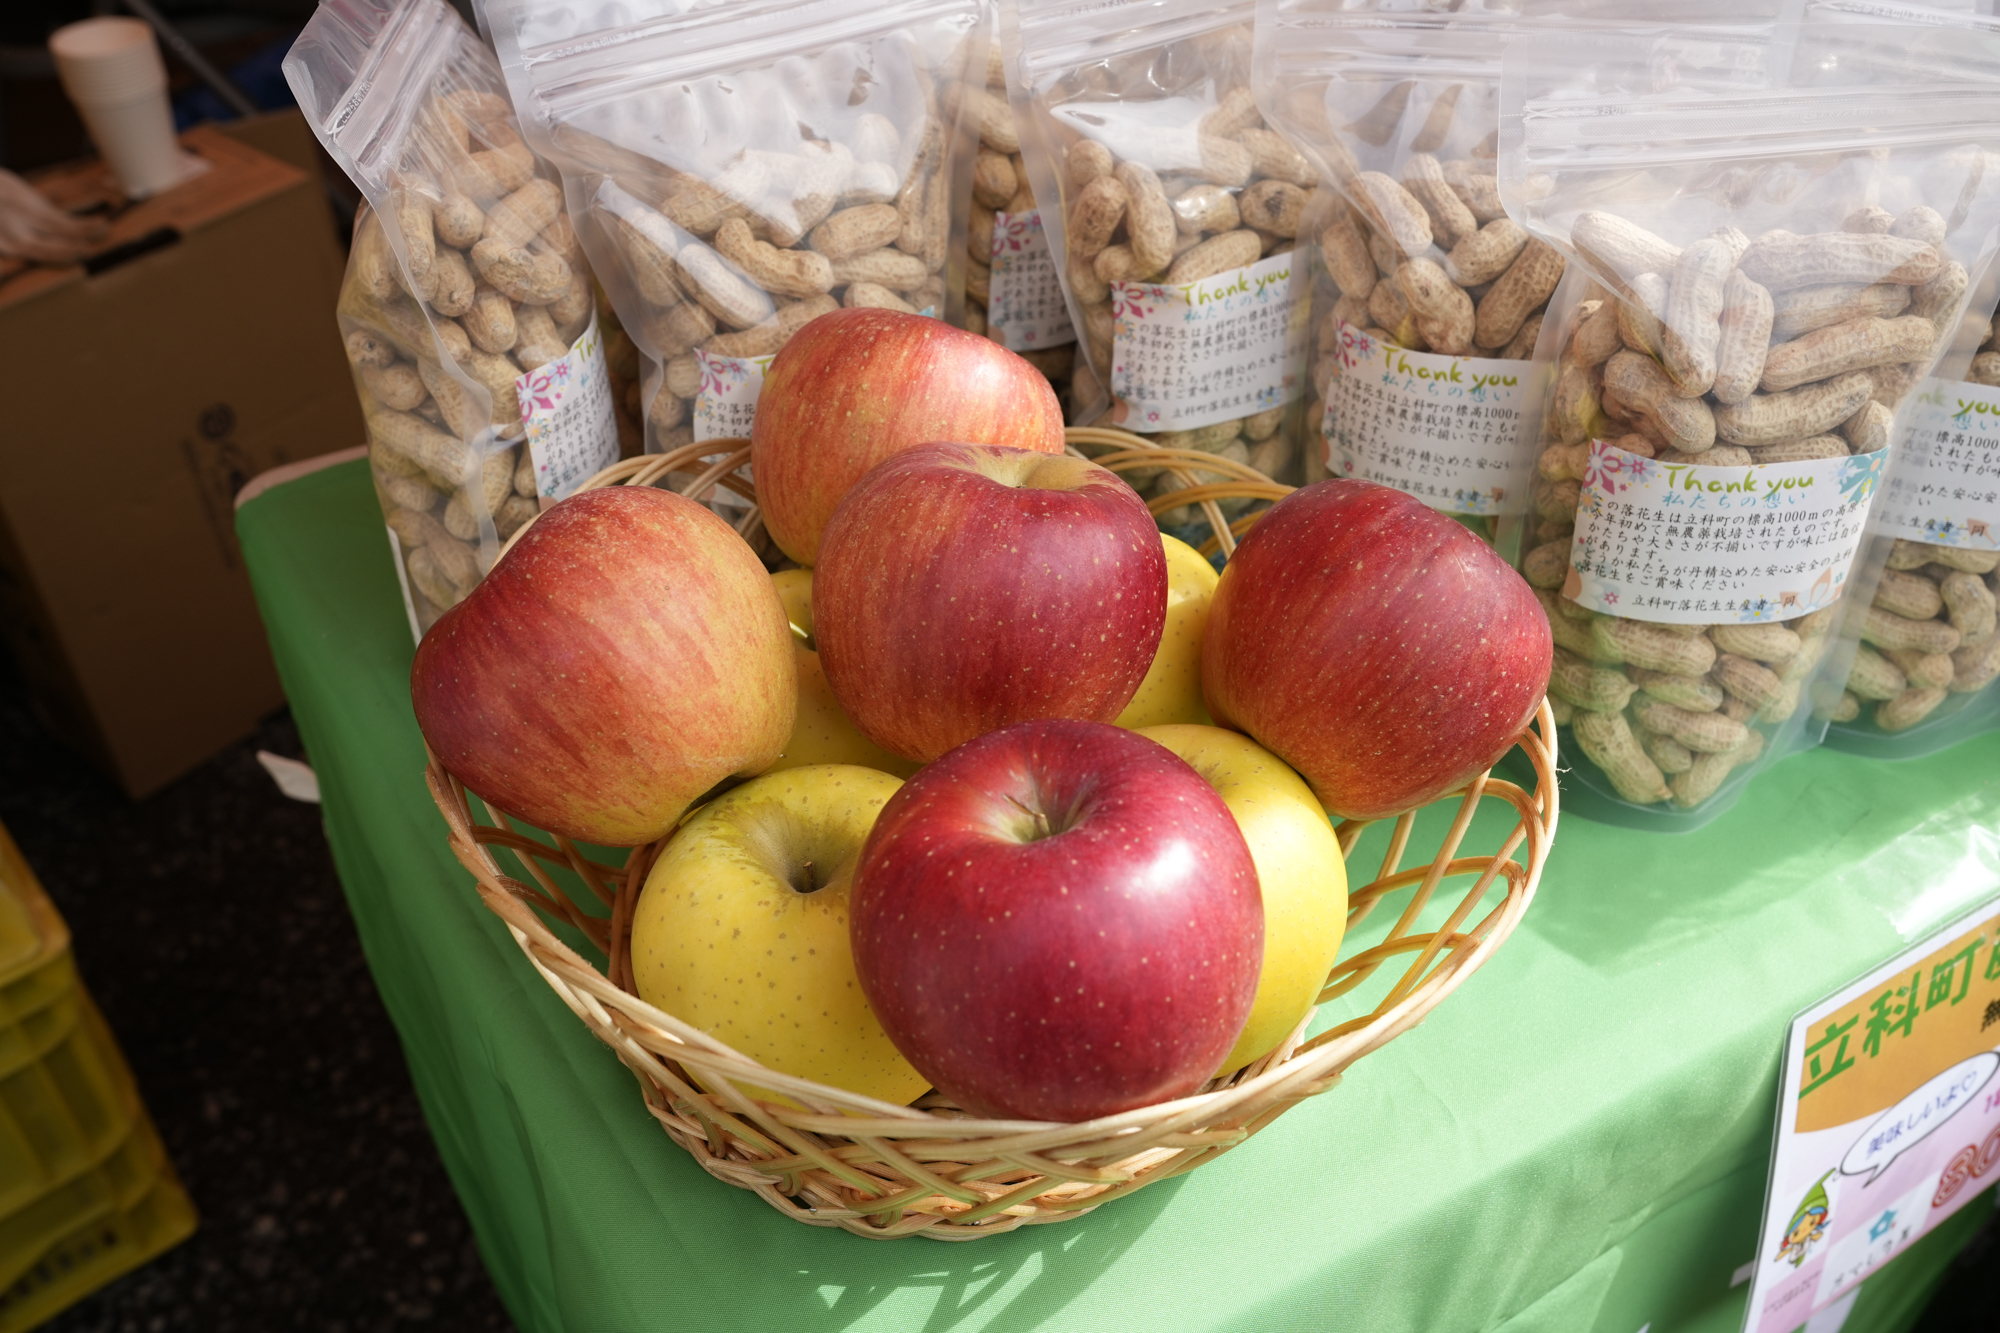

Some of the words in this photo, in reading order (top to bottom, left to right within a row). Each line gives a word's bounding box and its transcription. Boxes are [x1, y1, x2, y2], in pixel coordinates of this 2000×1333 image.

[1178, 271, 1249, 306] Thank
[1255, 268, 1289, 296] you
[1381, 345, 1463, 383] Thank
[1468, 373, 1518, 393] you
[1663, 465, 1757, 493] Thank
[1762, 476, 1814, 499] you
[1661, 490, 1806, 510] 私たちの想い
[1586, 535, 1662, 563] があります。
[1581, 559, 1744, 591] 落花生をご賞味ください
[1632, 594, 1796, 612] 立科町落花生生産者一同
